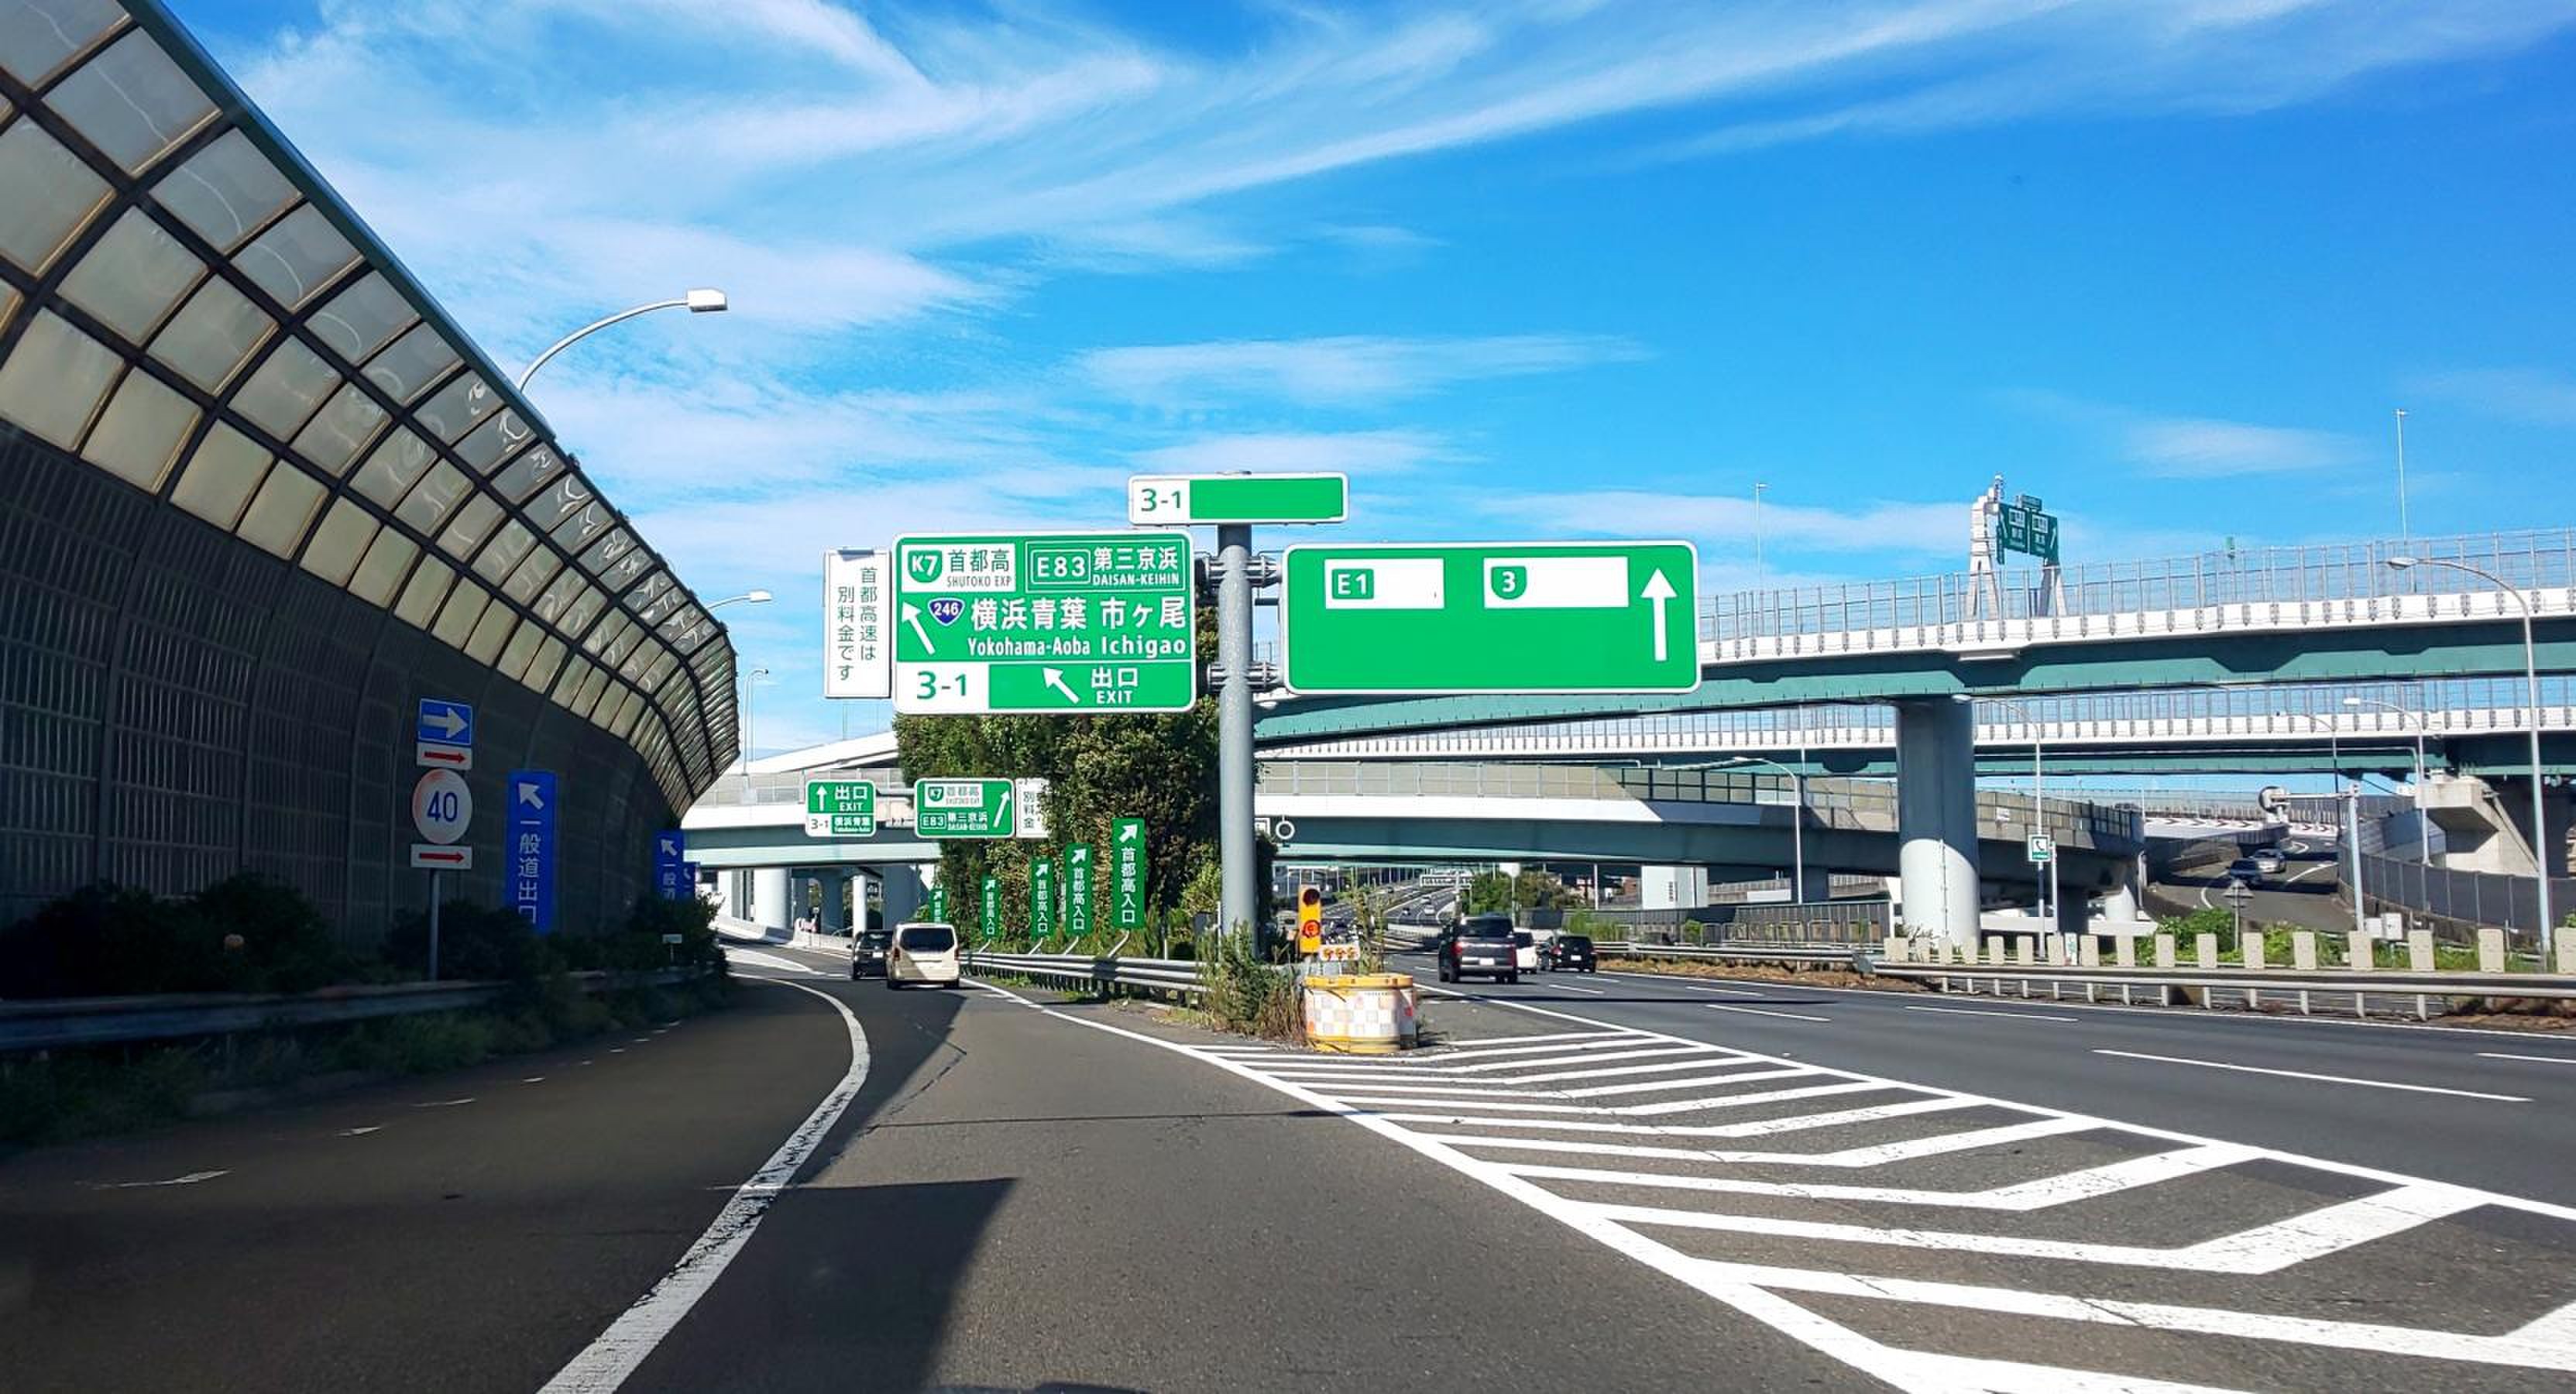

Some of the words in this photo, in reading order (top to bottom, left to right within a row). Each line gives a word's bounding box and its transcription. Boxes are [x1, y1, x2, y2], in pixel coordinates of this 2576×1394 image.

[1141, 488, 1180, 512] 3-1
[912, 555, 938, 576] K7
[948, 548, 1009, 572] 首都高
[1037, 556, 1085, 577] E83
[1094, 546, 1178, 571] 第三京浜
[946, 575, 991, 587] SHUTOKO
[994, 575, 1012, 586] EXP
[1092, 573, 1179, 585] DAISAN-KEIHIN
[1338, 573, 1367, 595] E1
[1503, 571, 1516, 592] 3
[860, 567, 878, 661] 首都高速は
[934, 602, 959, 616] 246
[971, 596, 1086, 630] 横浜青葉
[837, 585, 855, 681] 別料金です
[968, 635, 1091, 656] Yokohama-Aoba
[1101, 634, 1186, 658] Ichigao
[917, 671, 967, 699] 3-1
[1091, 666, 1138, 688] 出口
[1096, 690, 1132, 704] EXIT
[835, 785, 867, 800] 出口
[427, 791, 459, 822] 40
[840, 802, 864, 812] EXIT
[811, 819, 828, 829] 3-1
[922, 816, 943, 826] E83
[1121, 846, 1136, 923] 首都高入口
[1073, 867, 1085, 929] 首都高入口
